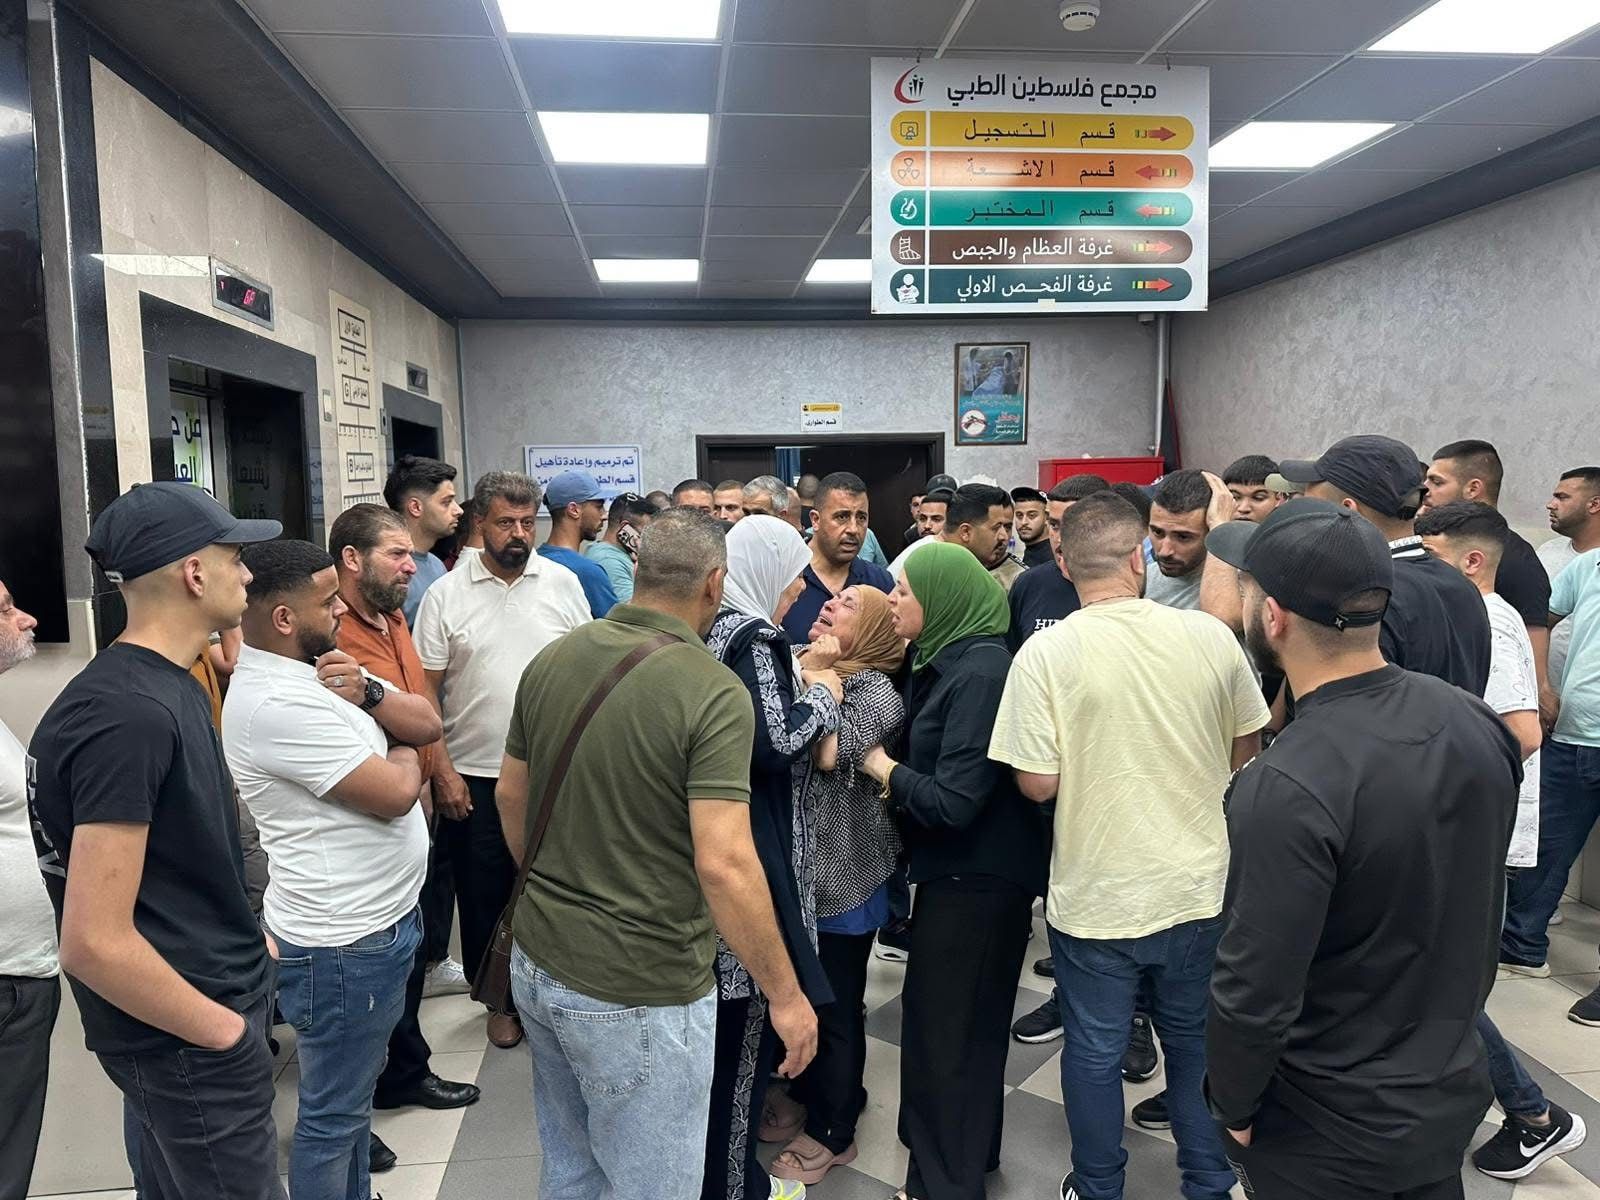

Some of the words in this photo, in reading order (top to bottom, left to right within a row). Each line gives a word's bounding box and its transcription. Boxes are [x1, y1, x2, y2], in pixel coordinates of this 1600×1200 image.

[947, 73, 1005, 107] الطبي
[1012, 75, 1094, 102] فلسطين
[1100, 83, 1157, 107] مجمع
[964, 118, 1055, 142] التسجيل
[1080, 122, 1116, 148] قسم
[1079, 160, 1115, 185] قسم
[965, 199, 1054, 223] المختبر
[1079, 200, 1114, 224] قسم
[952, 236, 1016, 260] والجبص
[1022, 236, 1073, 264] العظام
[1078, 237, 1114, 259] غرفة
[957, 274, 996, 302] الاولي
[1001, 274, 1072, 297] الفحص
[1077, 274, 1113, 296] غرفة
[594, 456, 620, 468] ترميم
[622, 456, 634, 467] تم
[615, 474, 636, 487] قسم
